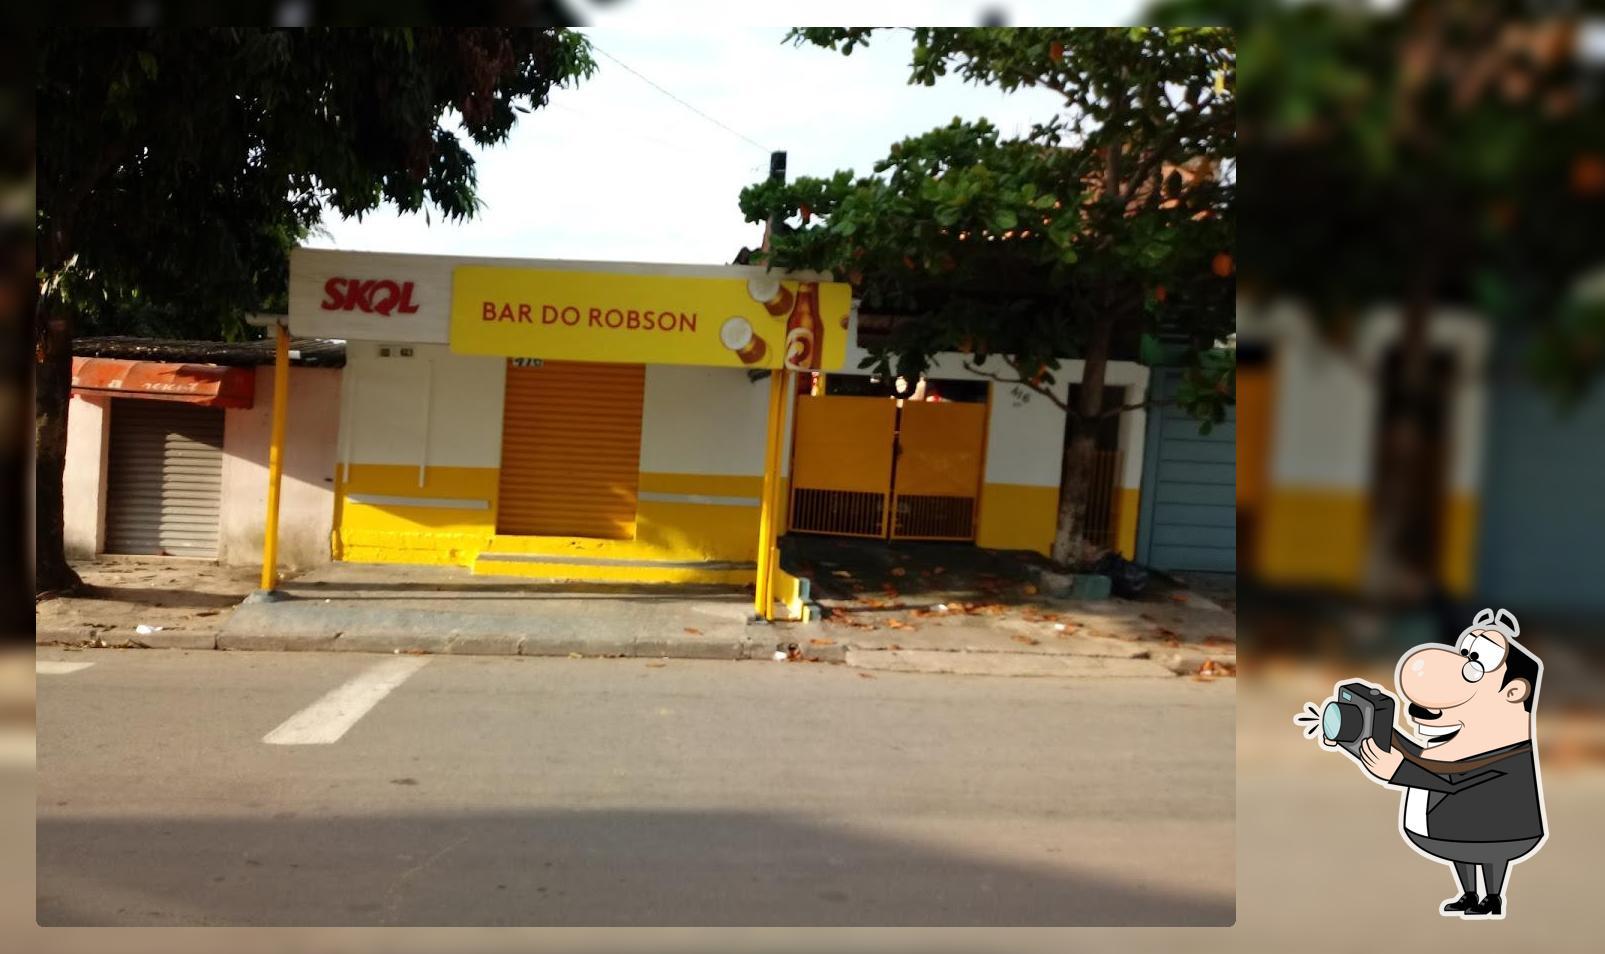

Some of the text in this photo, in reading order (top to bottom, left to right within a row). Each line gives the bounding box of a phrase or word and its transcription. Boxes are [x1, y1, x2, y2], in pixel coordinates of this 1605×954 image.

[482, 302, 697, 332] BAR DO ROBSON
